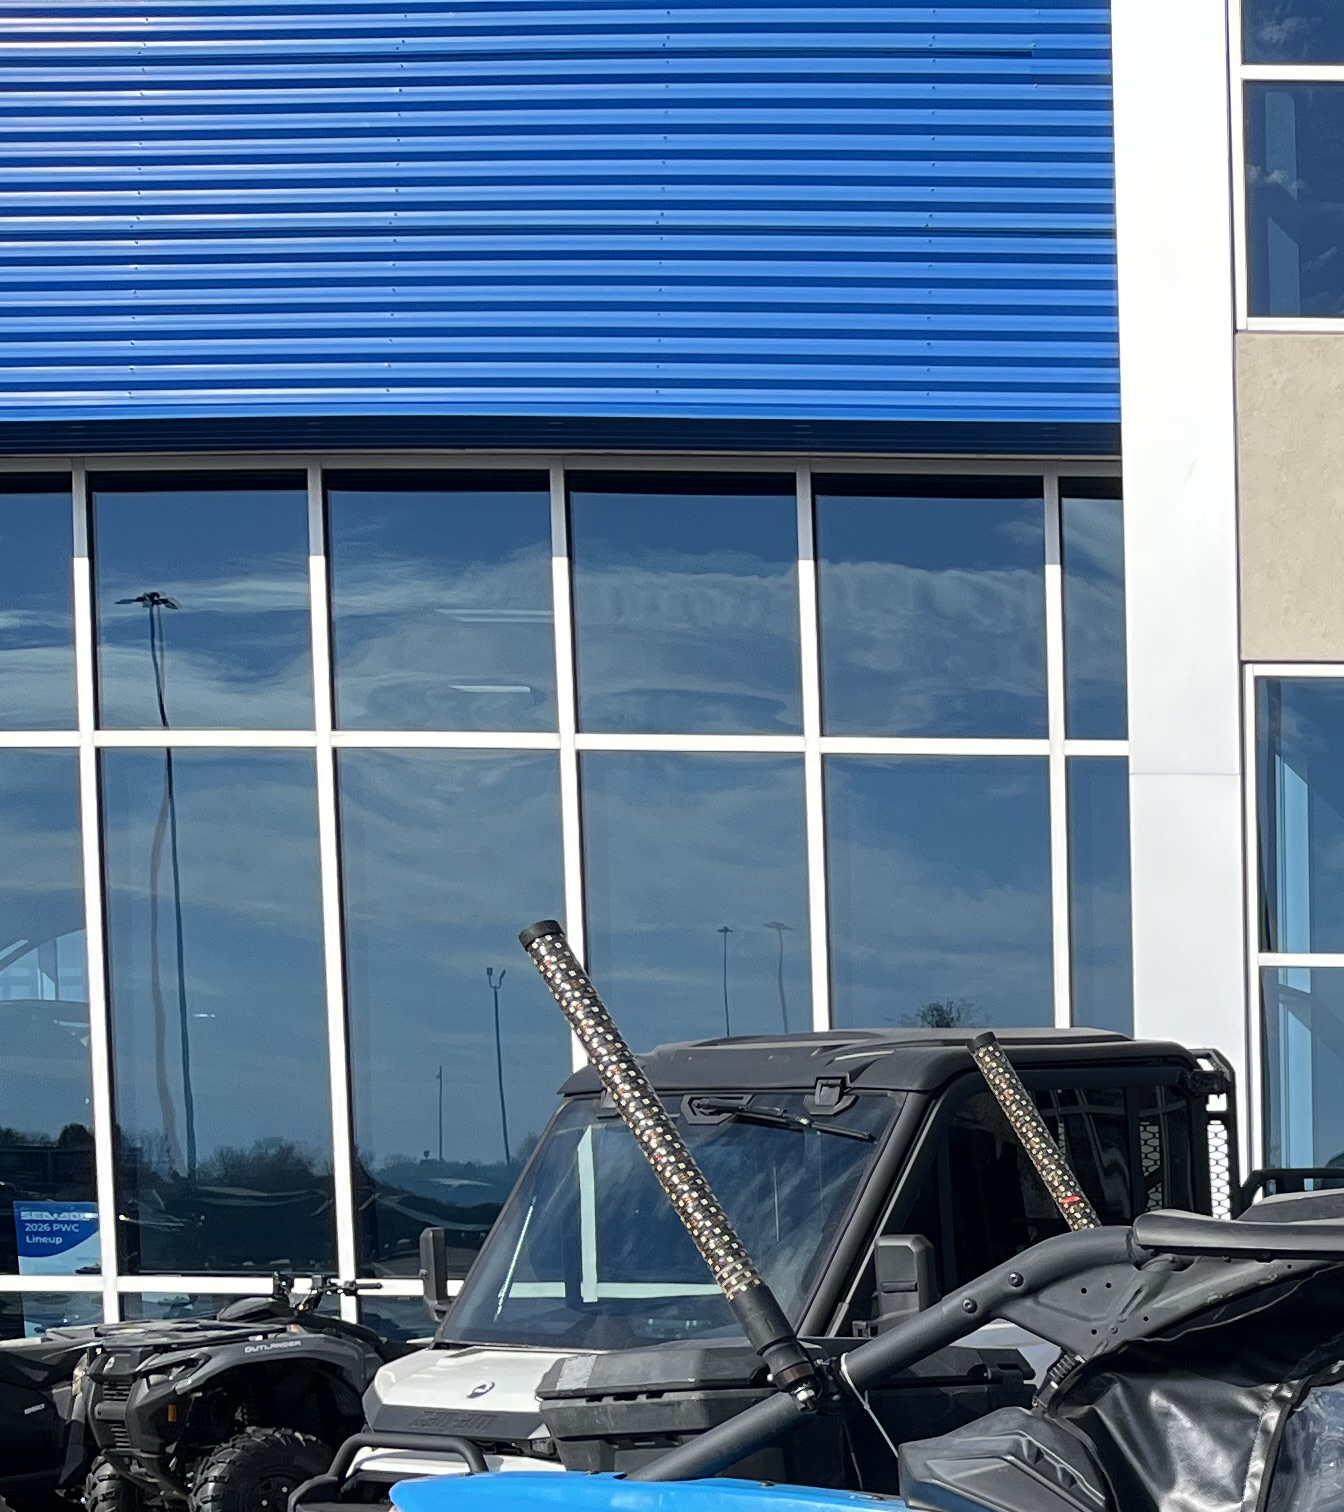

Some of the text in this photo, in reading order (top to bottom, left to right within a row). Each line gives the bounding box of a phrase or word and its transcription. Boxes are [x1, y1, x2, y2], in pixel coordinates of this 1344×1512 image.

[25, 1223, 79, 1232] 2026 PWC
[26, 1235, 63, 1245] Lineup
